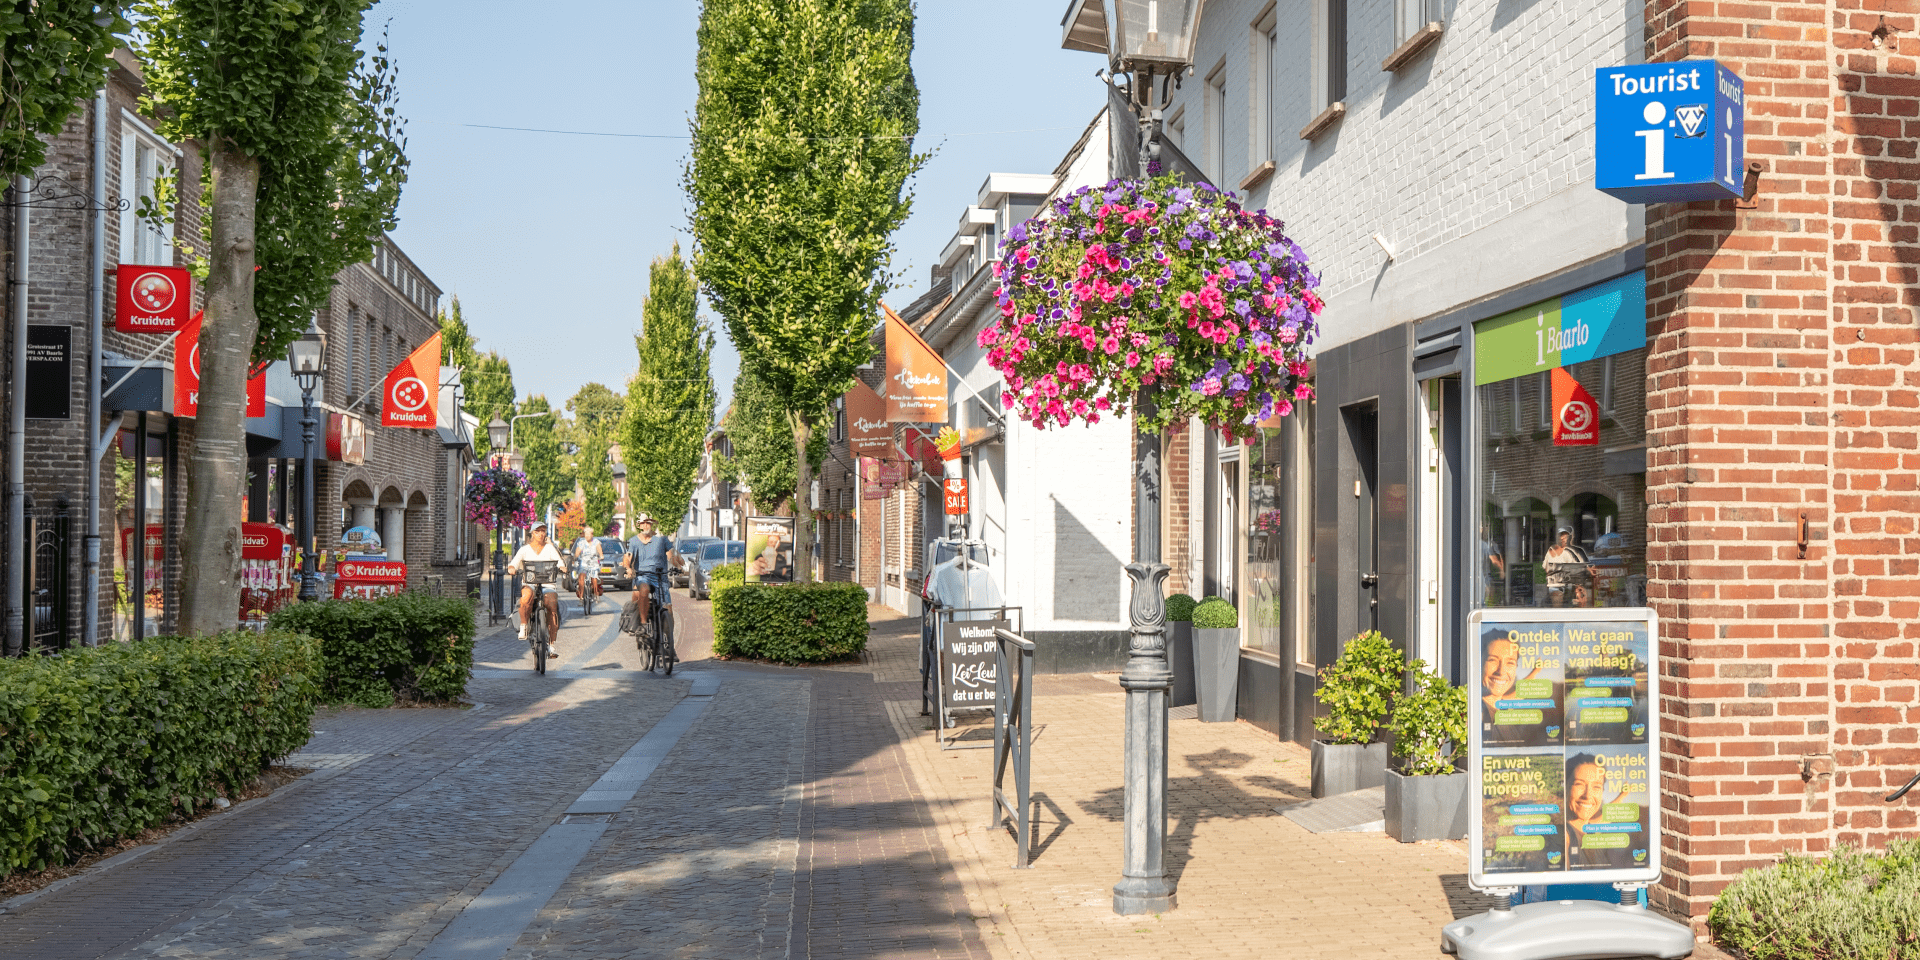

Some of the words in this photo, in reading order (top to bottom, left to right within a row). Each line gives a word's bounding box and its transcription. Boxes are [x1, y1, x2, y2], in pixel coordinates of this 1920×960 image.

[1610, 68, 1700, 96] Tourist
[1718, 70, 1741, 106] Tourist
[130, 315, 176, 326] Kruidvat
[1546, 318, 1589, 354] Baarlo
[390, 412, 427, 422] Kruidvat
[947, 496, 966, 508] SALE
[356, 565, 402, 576] Kruidvat
[959, 626, 996, 638] Welkom!
[1508, 629, 1560, 643] Ontdek
[1568, 629, 1597, 642] Wat
[1599, 631, 1634, 645] gaan
[951, 642, 967, 656] Wij
[967, 641, 983, 655] zijn
[1510, 643, 1540, 656] Peel
[1542, 645, 1560, 656] en
[1568, 644, 1590, 655] we
[1592, 642, 1624, 655] eten
[1521, 656, 1560, 669] Maas
[1568, 653, 1637, 671] vandaag?
[952, 689, 967, 701] dat
[967, 692, 974, 700] u
[974, 691, 983, 700] er
[1483, 756, 1501, 770] En
[1504, 756, 1531, 769] wat
[1594, 753, 1646, 767] Ontdek
[1483, 769, 1519, 782] doen
[1521, 771, 1543, 781] we
[1596, 766, 1626, 780] Peel
[1629, 769, 1646, 780] en
[1483, 780, 1546, 798] morgen?
[1608, 780, 1647, 793] Maas
